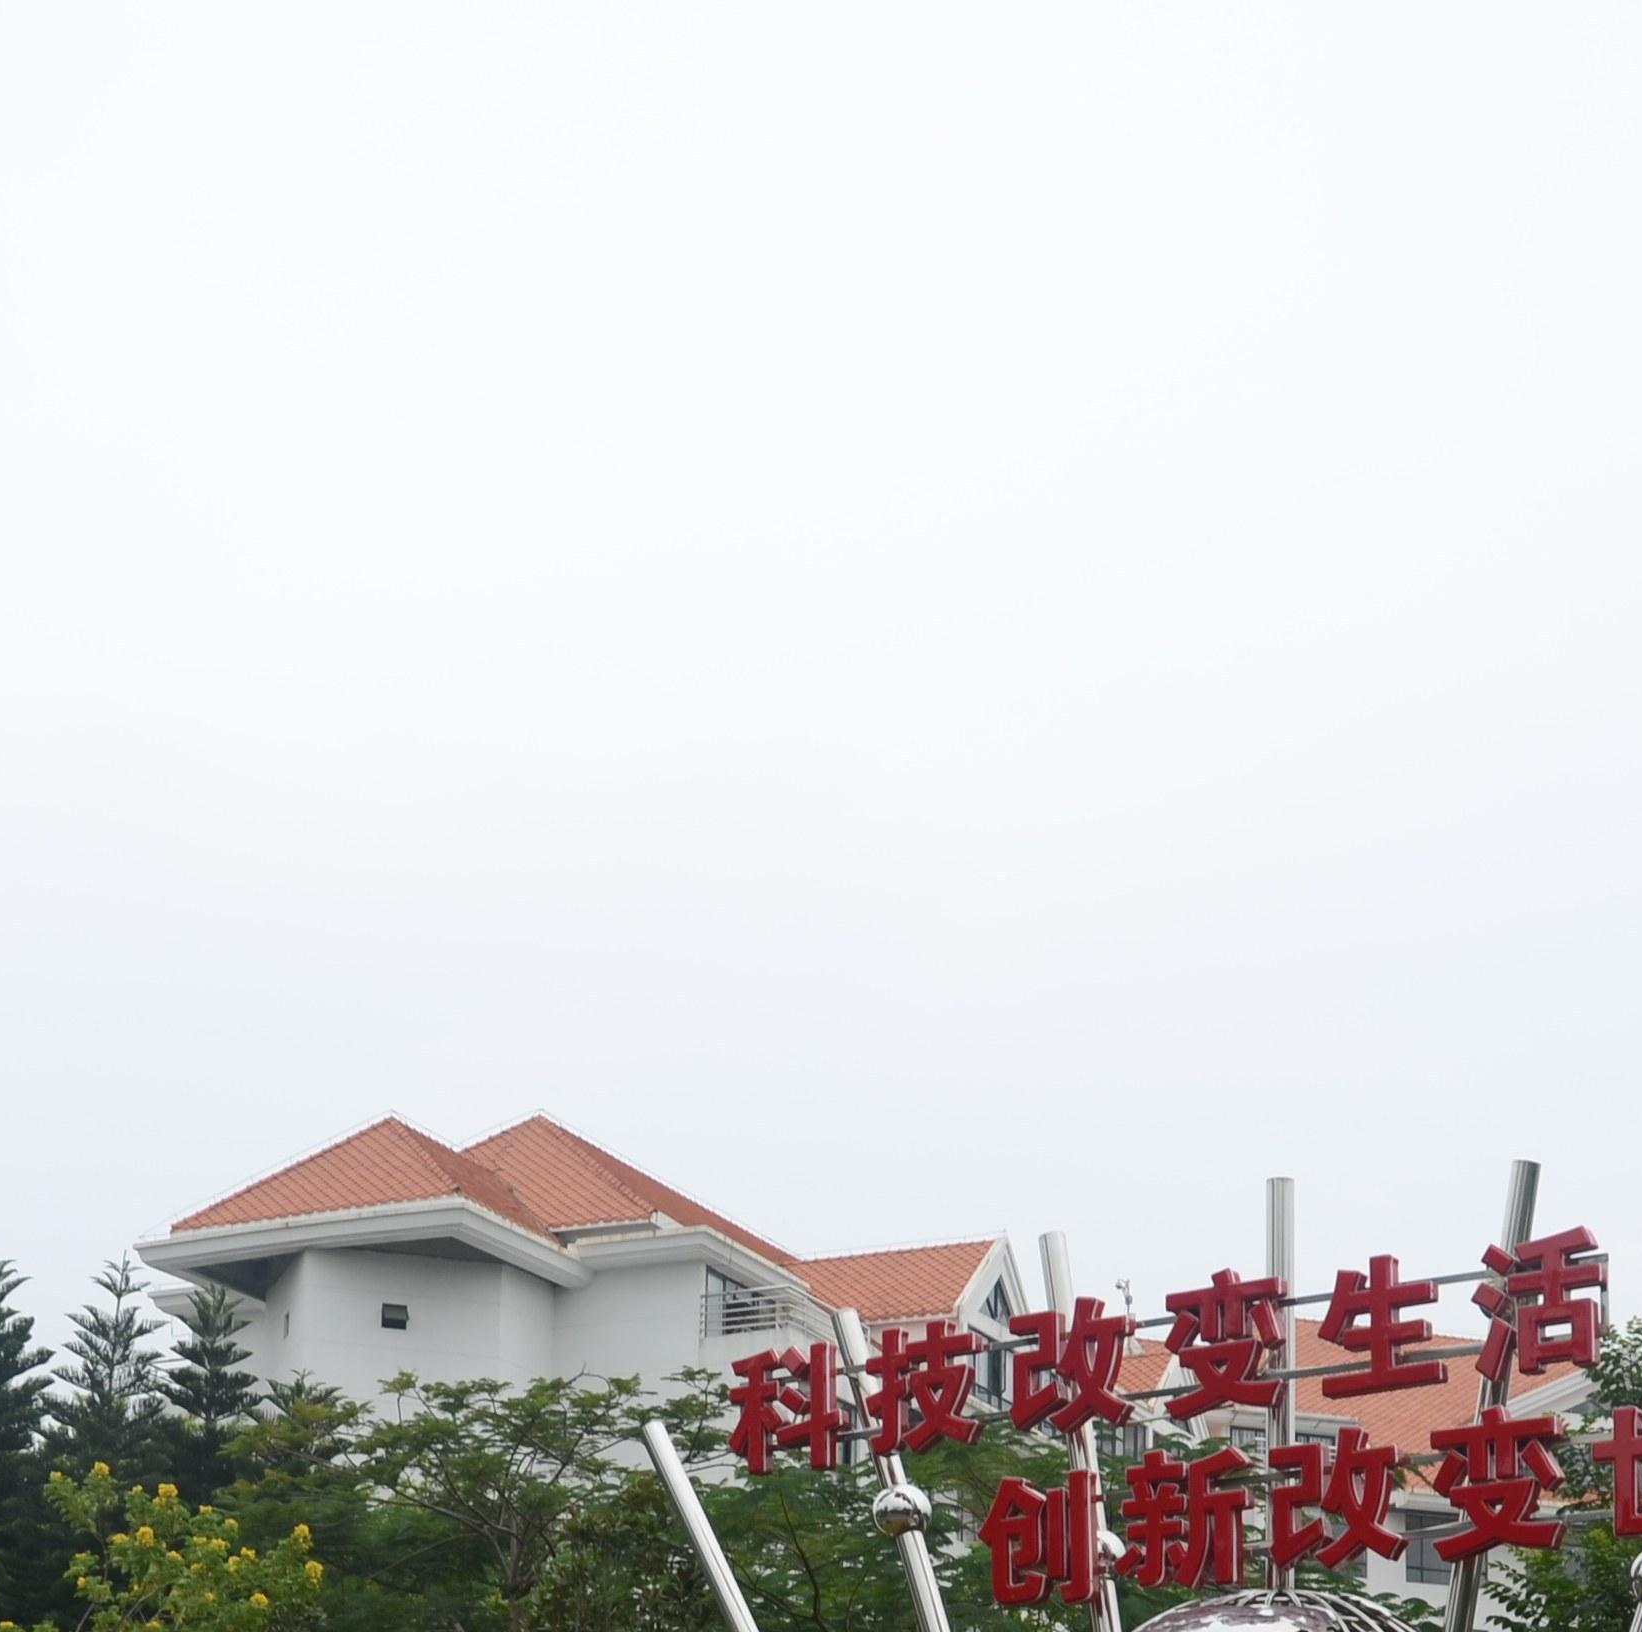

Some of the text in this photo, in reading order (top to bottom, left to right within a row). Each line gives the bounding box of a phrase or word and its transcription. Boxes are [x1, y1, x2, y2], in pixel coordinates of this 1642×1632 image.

[728, 1225, 1602, 1475] 科技改变生活
